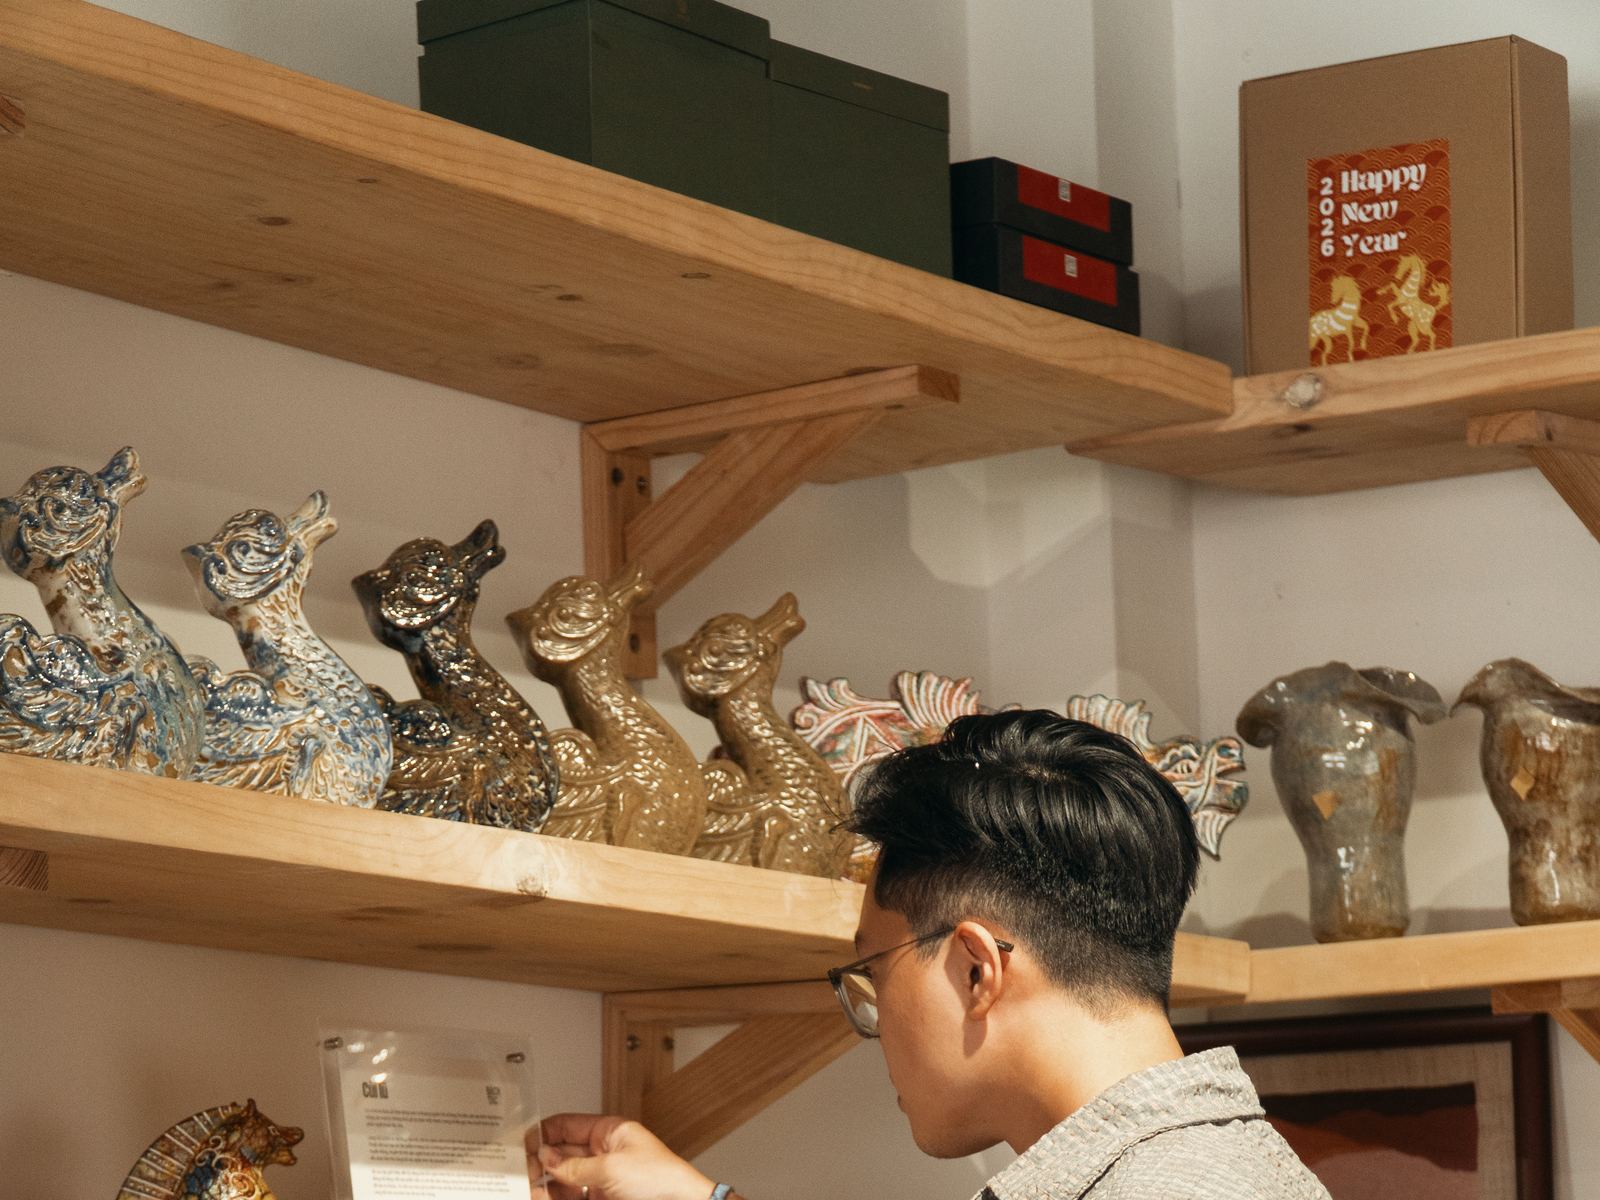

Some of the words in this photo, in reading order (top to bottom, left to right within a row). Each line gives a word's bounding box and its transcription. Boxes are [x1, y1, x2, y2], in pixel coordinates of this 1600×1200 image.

[1341, 163, 1427, 195] Happy
[1319, 176, 1335, 257] 2026
[1341, 200, 1398, 226] New
[1341, 231, 1408, 257] Year
